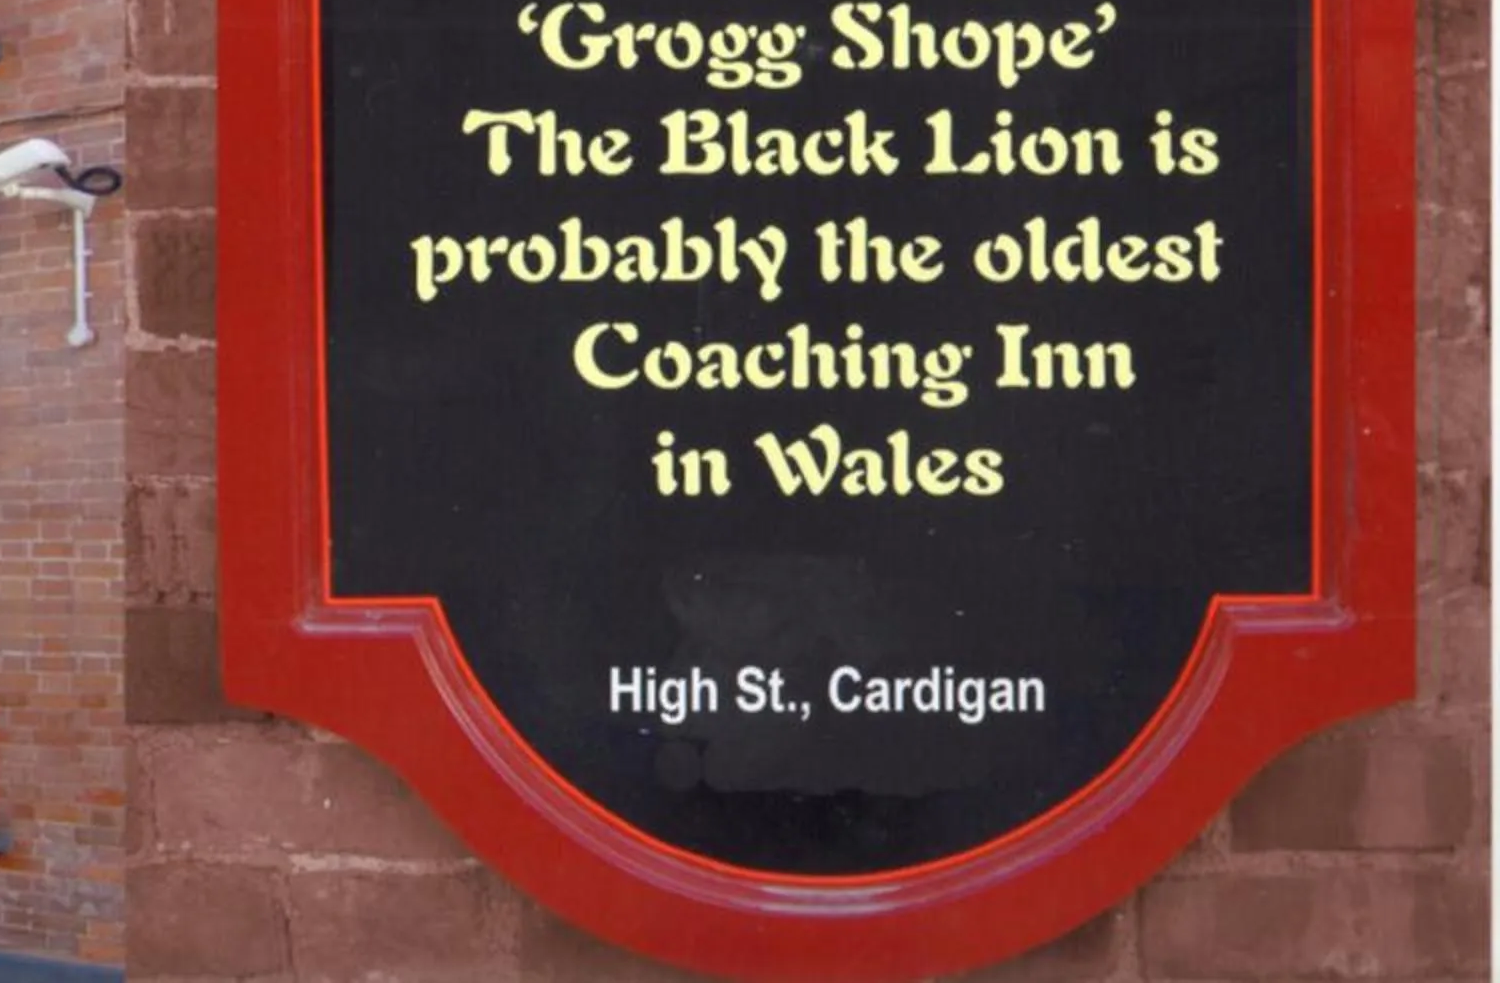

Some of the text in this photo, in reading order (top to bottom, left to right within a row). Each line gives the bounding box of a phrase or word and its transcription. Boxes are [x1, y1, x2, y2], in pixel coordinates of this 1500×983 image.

[517, 2, 1118, 90] ‘Grogg Shope’
[462, 109, 1221, 177] The Black Lion is
[410, 216, 1226, 303] probably the oldest
[573, 322, 1138, 409] Coaching Inn
[651, 423, 1006, 497] in Wales
[610, 666, 1047, 725] High St., Cardigan
